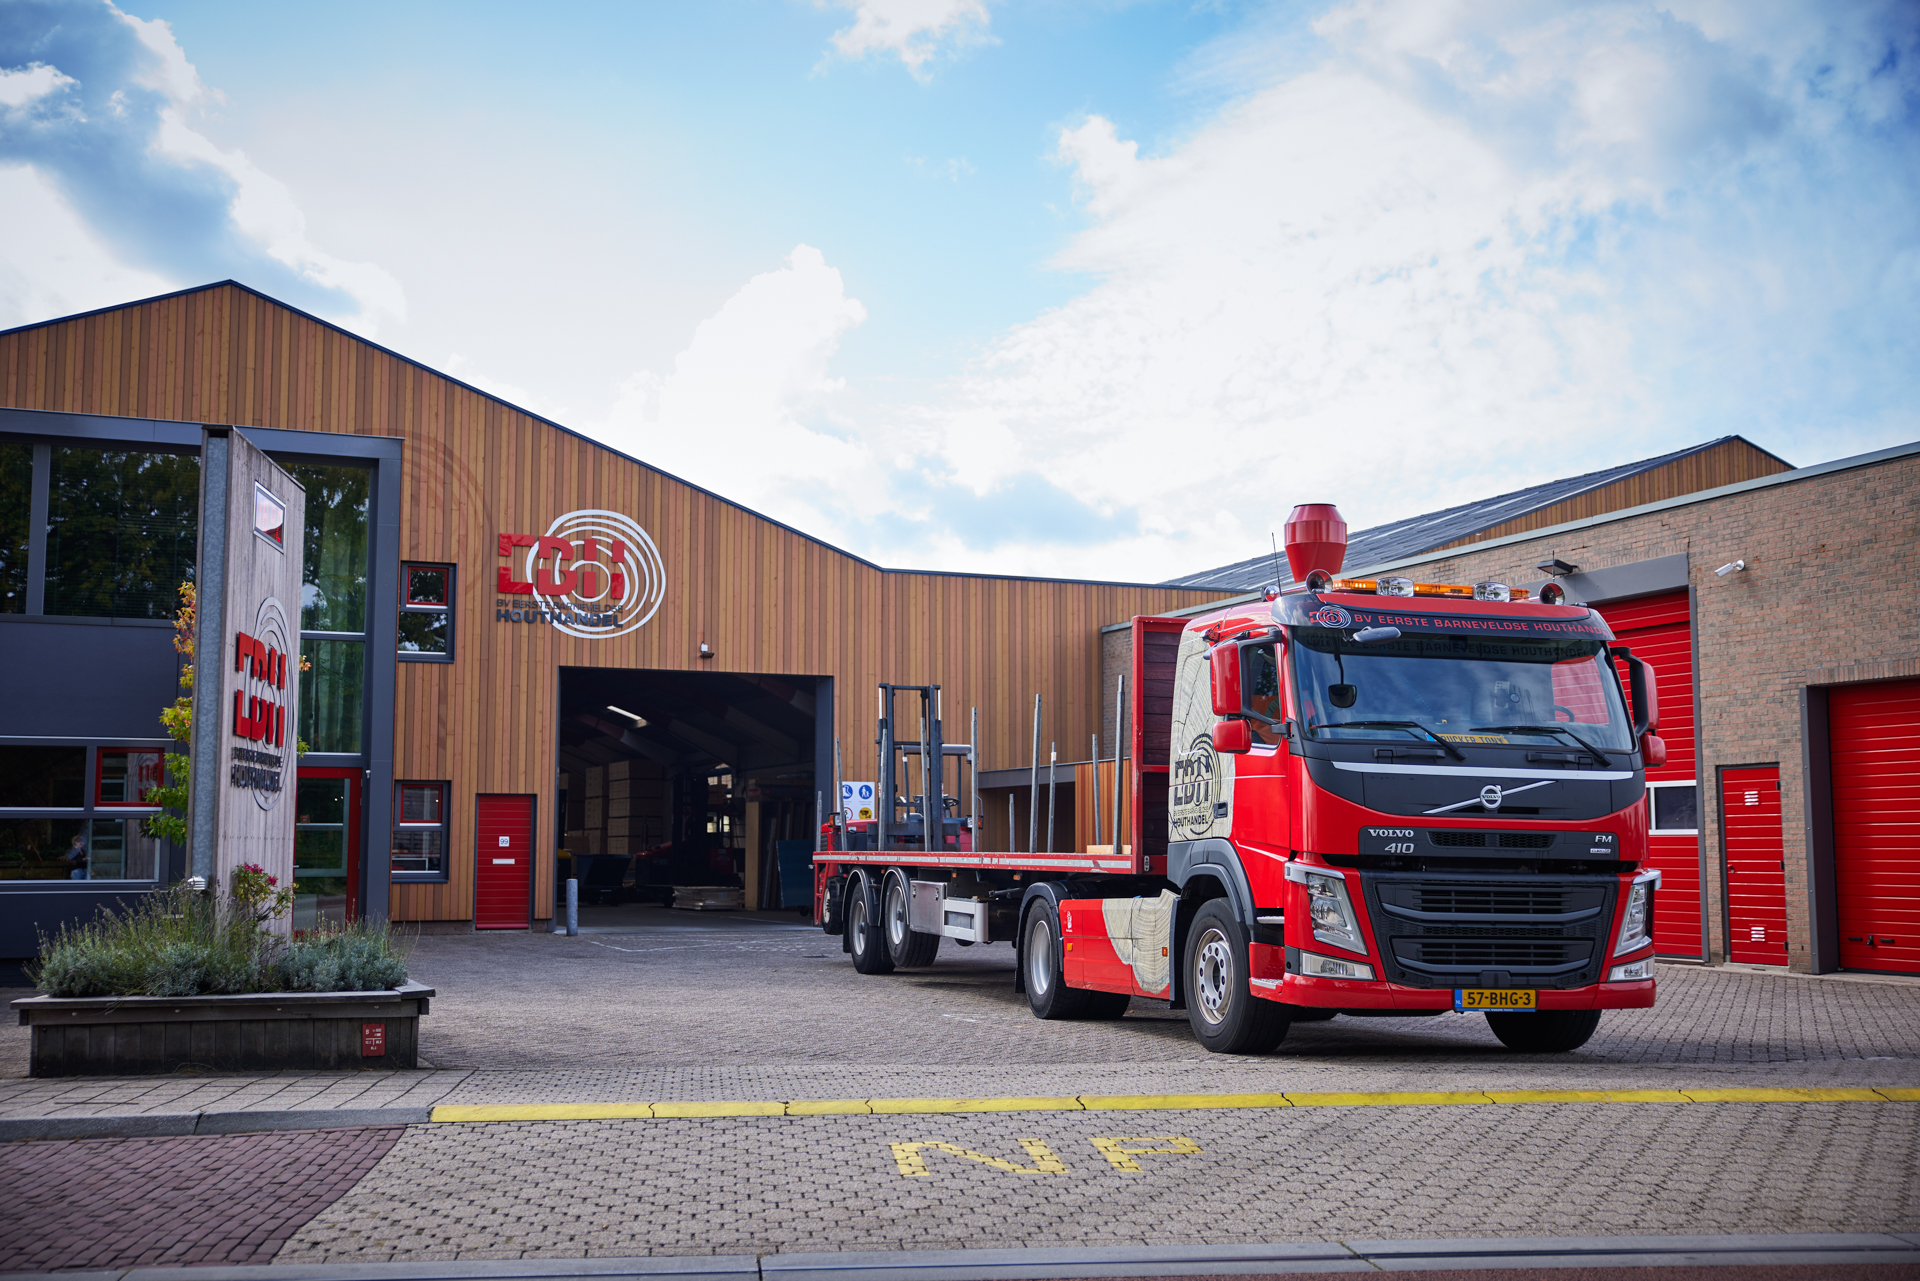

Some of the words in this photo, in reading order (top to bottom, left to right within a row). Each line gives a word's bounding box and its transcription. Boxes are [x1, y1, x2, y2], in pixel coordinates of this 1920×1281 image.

[497, 599, 511, 607] BV
[513, 599, 551, 610] EERSTE
[553, 601, 624, 613] BARNEVELDSE
[496, 608, 624, 628] HOUTHANDEL
[1354, 614, 1372, 623] BV
[1377, 616, 1429, 627] EERSTE
[1434, 619, 1530, 631] BARNEVELDSE
[1440, 735, 1476, 744] RUCKER
[1368, 828, 1414, 838] VOLVO
[1595, 835, 1612, 843] FM
[1384, 843, 1414, 854] 410
[1467, 992, 1531, 1006] 57-BHG-3
